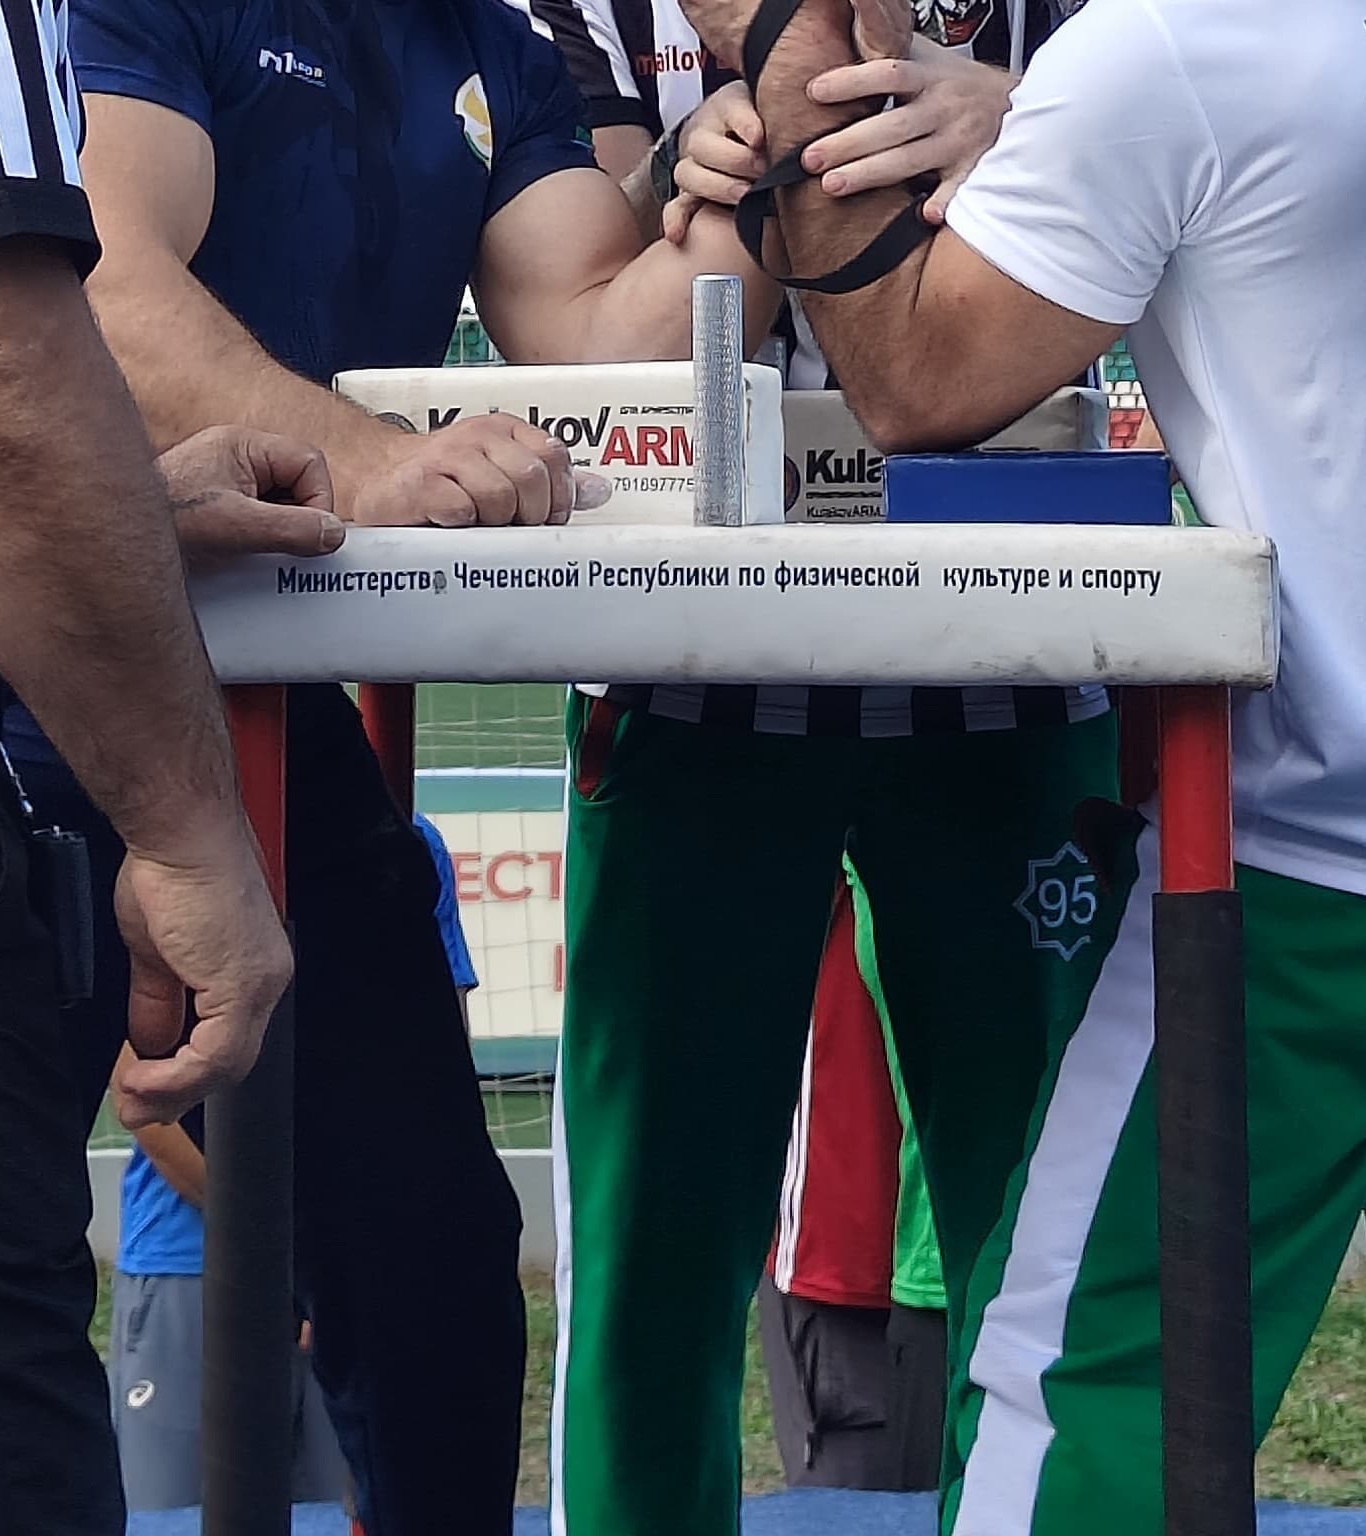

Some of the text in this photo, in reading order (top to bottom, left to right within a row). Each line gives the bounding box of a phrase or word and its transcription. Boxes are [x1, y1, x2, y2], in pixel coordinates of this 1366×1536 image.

[454, 560, 579, 590] Чеченской
[589, 560, 730, 593] Республики
[738, 565, 765, 587] по
[774, 560, 920, 592] физической
[943, 566, 1050, 594] культуре
[1059, 567, 1073, 589] и
[1081, 568, 1161, 596] спорту
[1038, 874, 1097, 928] 95
